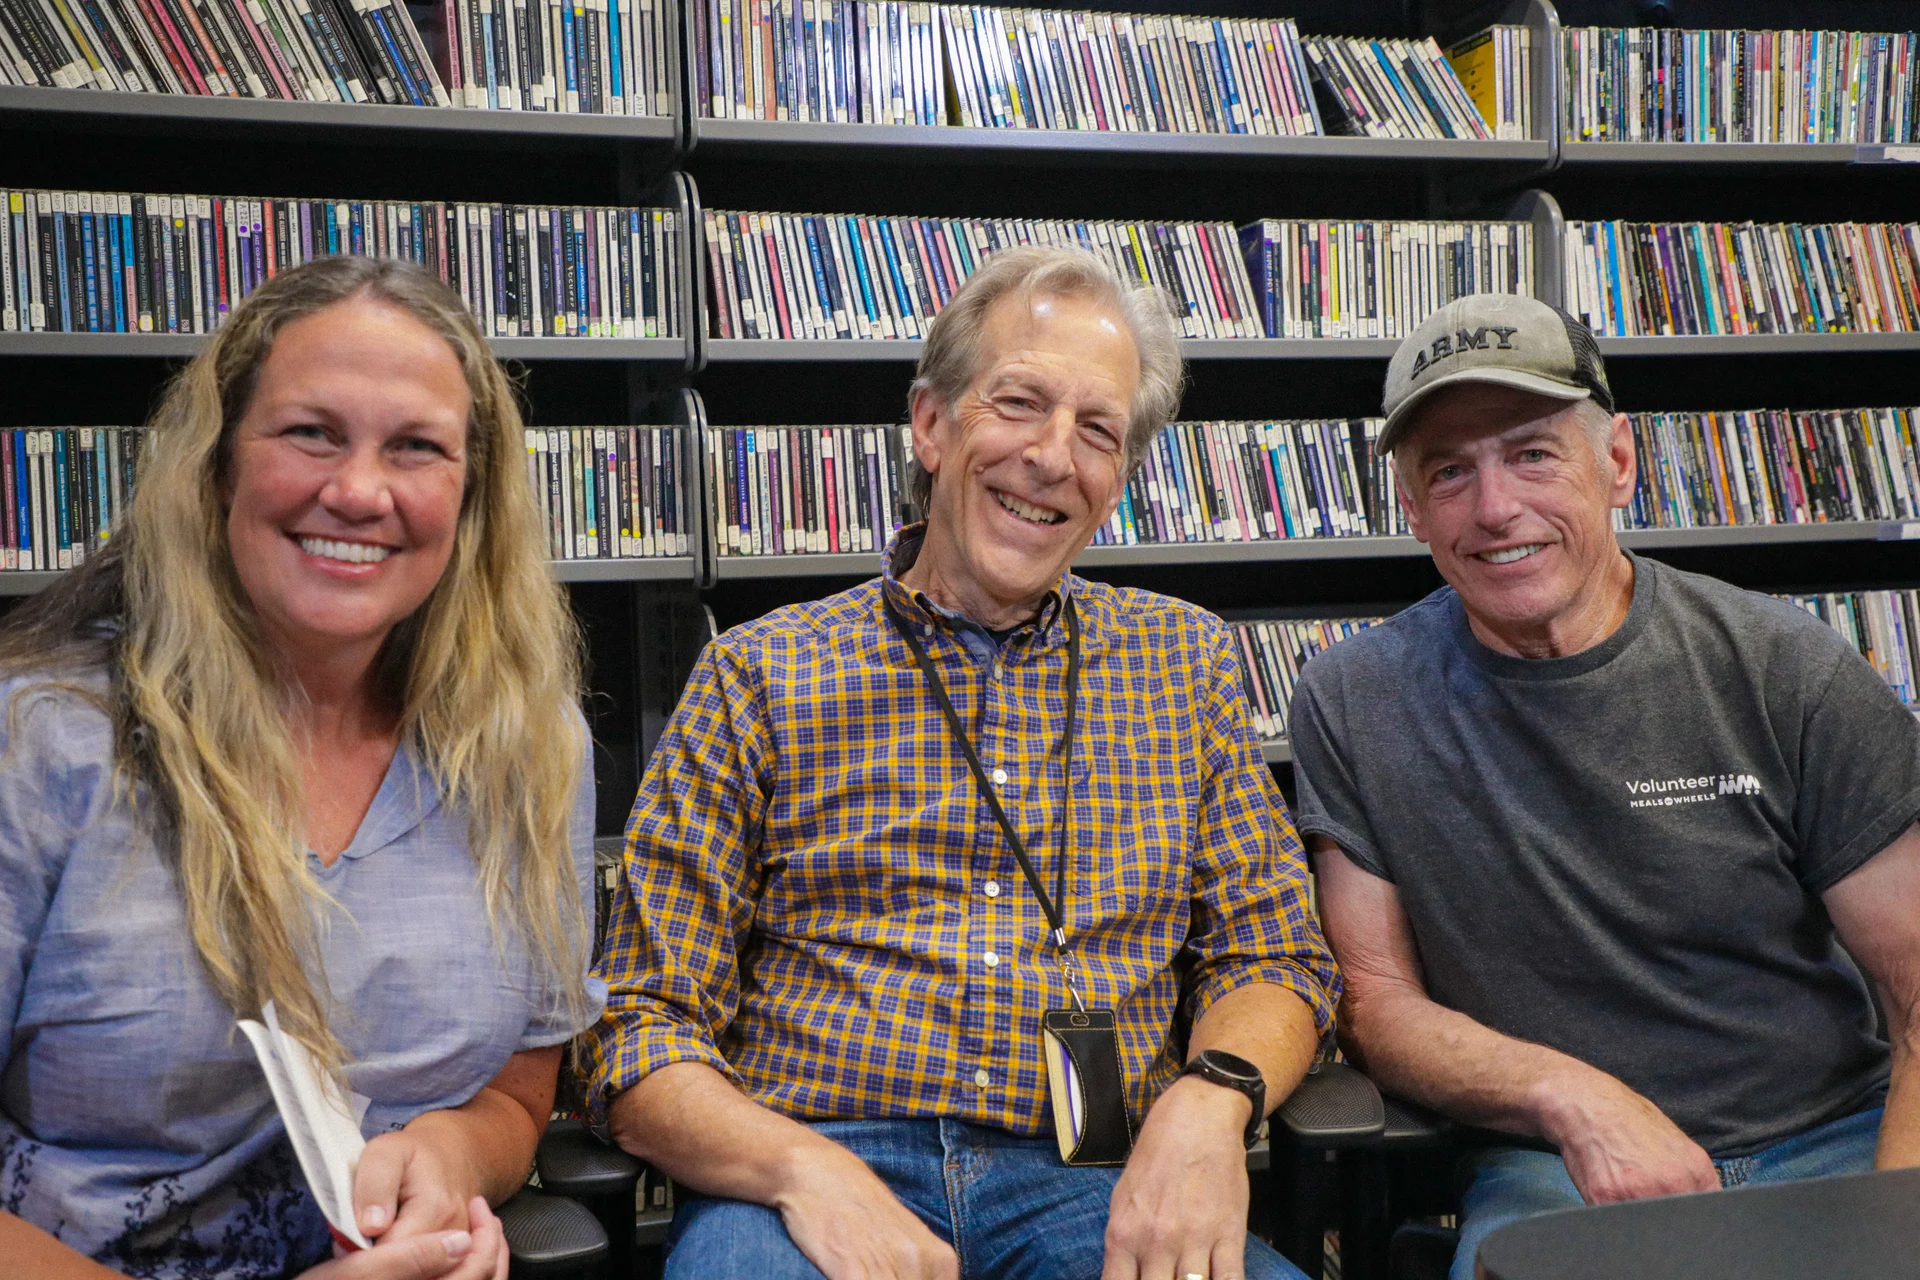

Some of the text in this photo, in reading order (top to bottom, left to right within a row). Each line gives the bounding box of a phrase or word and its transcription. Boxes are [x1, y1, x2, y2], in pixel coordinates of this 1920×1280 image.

[781, 254, 789, 271] BAKER
[1411, 326, 1518, 381] ARMY
[1626, 775, 1716, 795] Volunteer
[1631, 799, 1664, 808] MEALS
[1673, 793, 1716, 805] WHEELS
